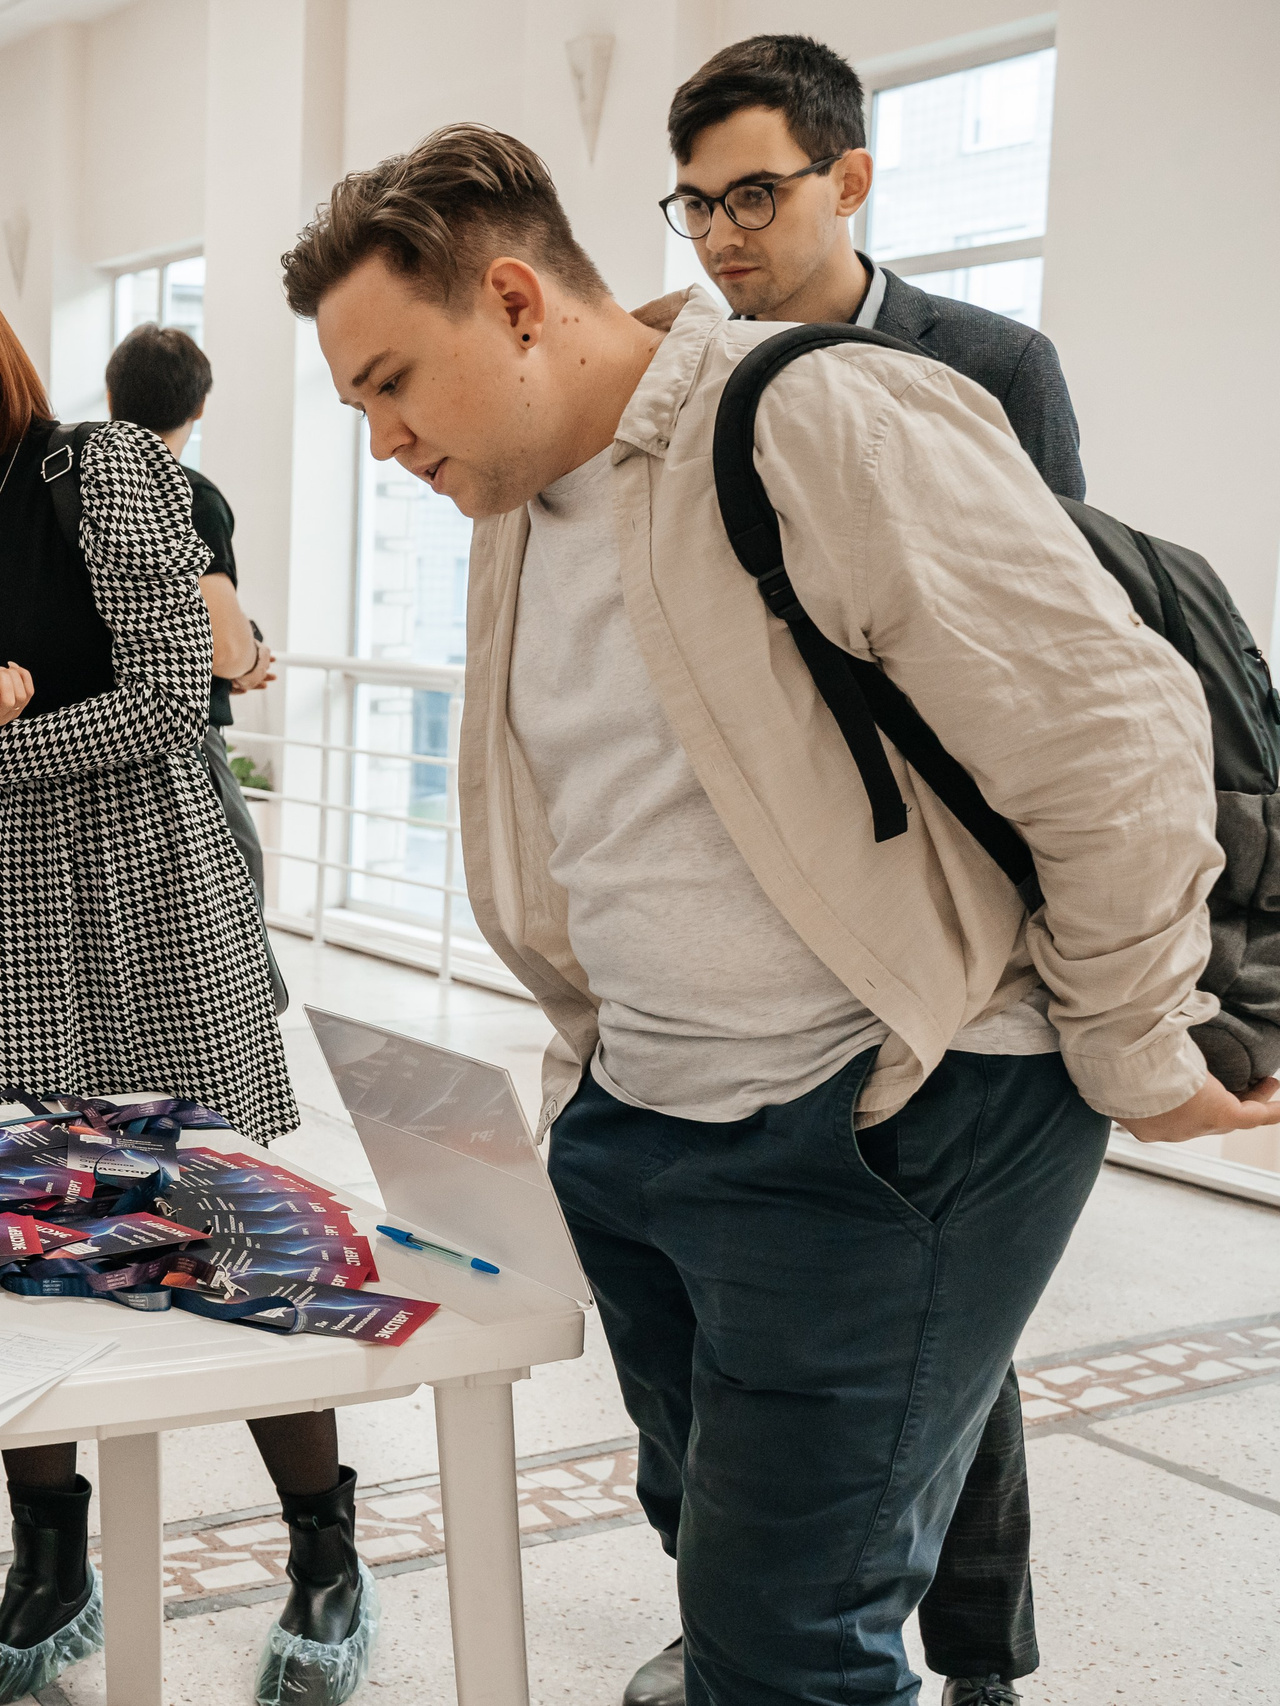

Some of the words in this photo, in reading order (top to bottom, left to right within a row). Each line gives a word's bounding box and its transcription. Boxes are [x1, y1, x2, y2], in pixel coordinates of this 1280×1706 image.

[7, 1226, 27, 1251] ЭКСПЕРТ
[330, 1313, 356, 1331] Наталья
[347, 1308, 381, 1334] Анатольевна
[374, 1310, 414, 1340] ЭКСПЕРТ
